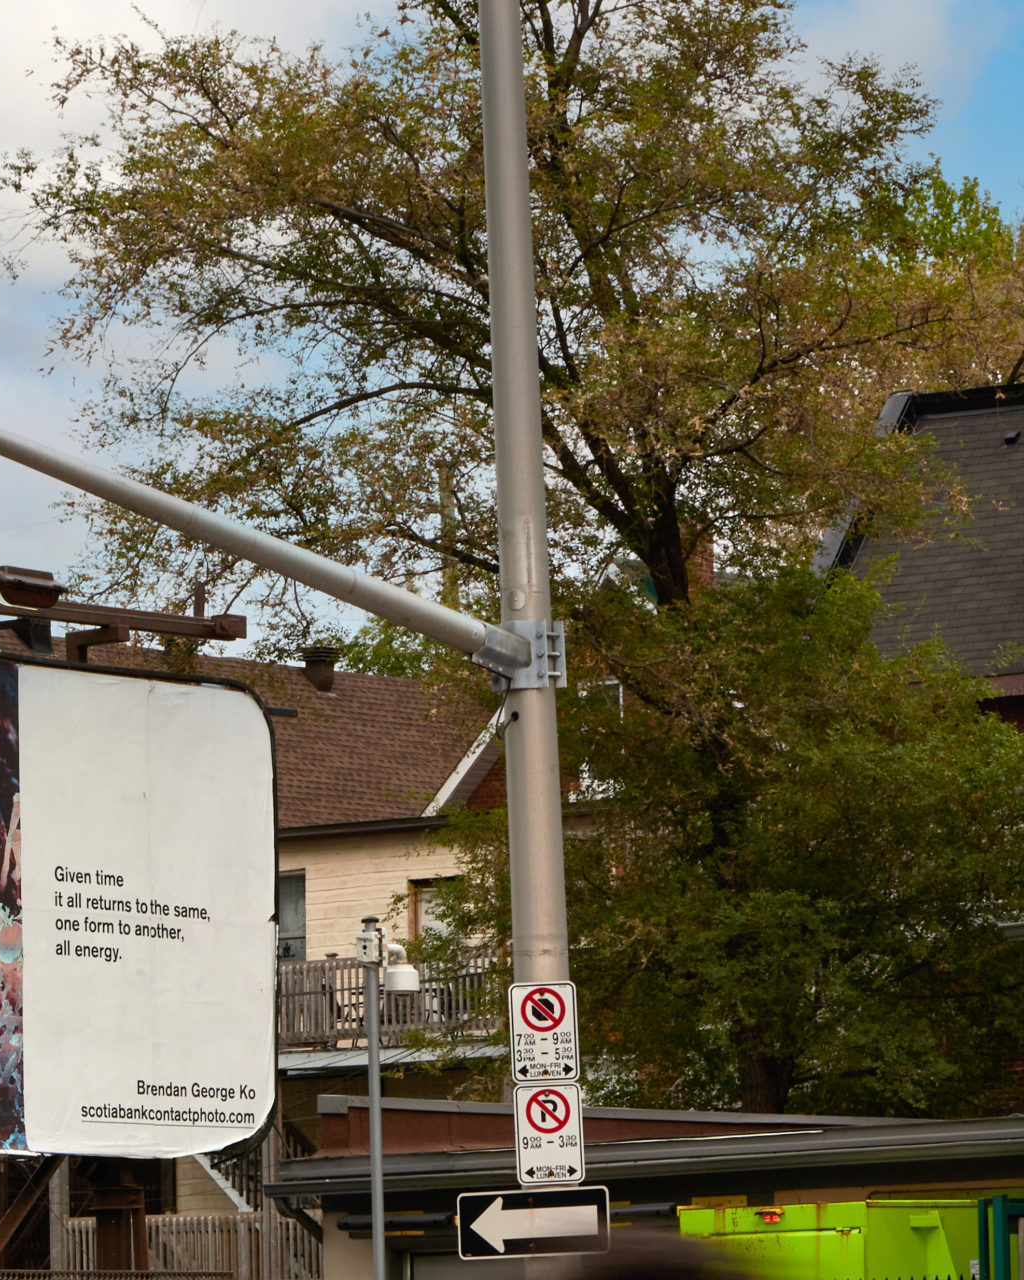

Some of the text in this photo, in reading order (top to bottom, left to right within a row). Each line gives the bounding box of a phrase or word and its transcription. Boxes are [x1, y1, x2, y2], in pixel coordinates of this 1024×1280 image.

[54, 865, 124, 888] Given time
[54, 890, 211, 923] it all returns to the same,
[55, 916, 185, 942] one form to another,
[55, 939, 123, 963] all energy.
[137, 1079, 256, 1101] Brendan George Ko
[81, 1103, 255, 1125] scotiabankcontactphoto.com
